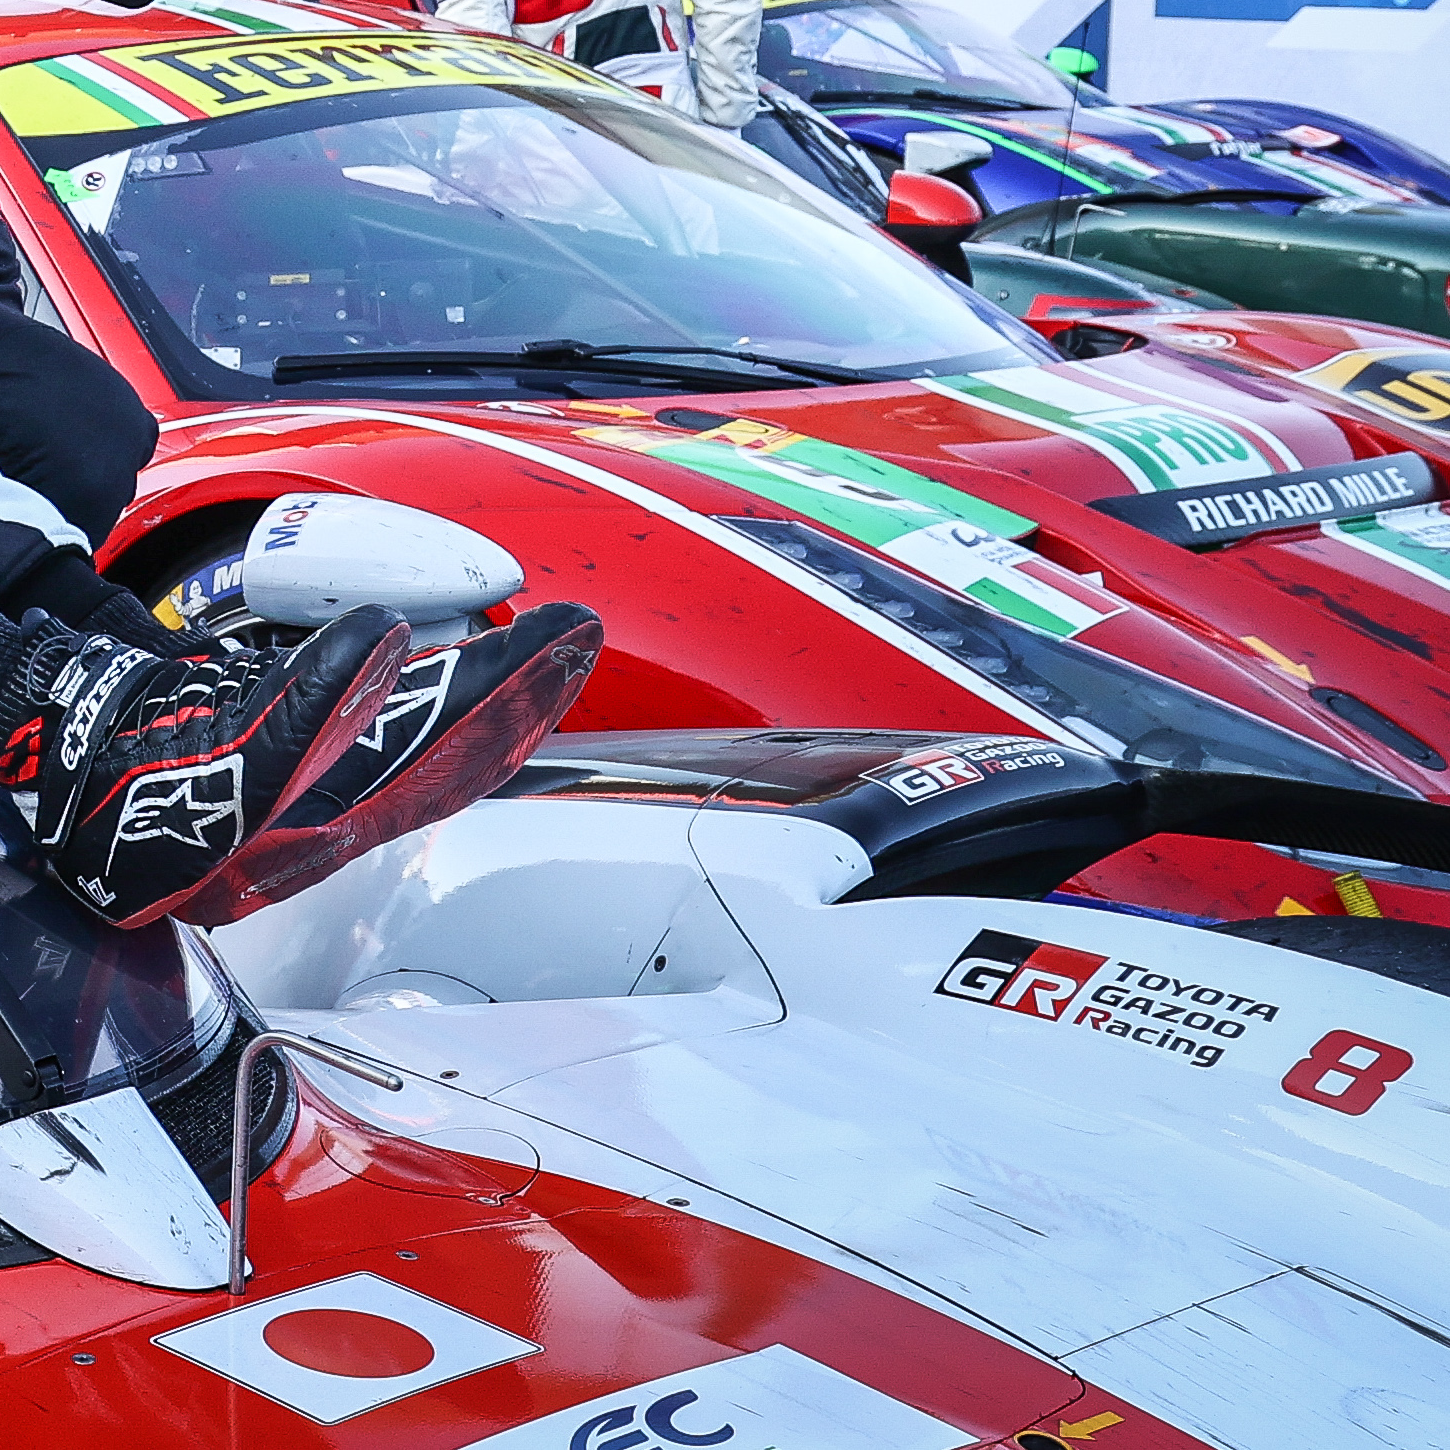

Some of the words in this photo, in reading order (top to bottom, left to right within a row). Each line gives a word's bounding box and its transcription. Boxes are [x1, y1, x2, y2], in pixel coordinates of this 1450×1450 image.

[1177, 481, 1334, 532] RICHARD
[1327, 467, 1415, 509] MILLE
[889, 757, 980, 799] GR
[964, 742, 1048, 761] GAZOO
[981, 752, 1066, 774] Racing
[944, 957, 1078, 1019] GR
[1090, 986, 1247, 1040] GAZOO
[1116, 961, 1280, 1022] TOYOTA
[1073, 1006, 1227, 1068] Racing
[1281, 1029, 1414, 1117] 8
